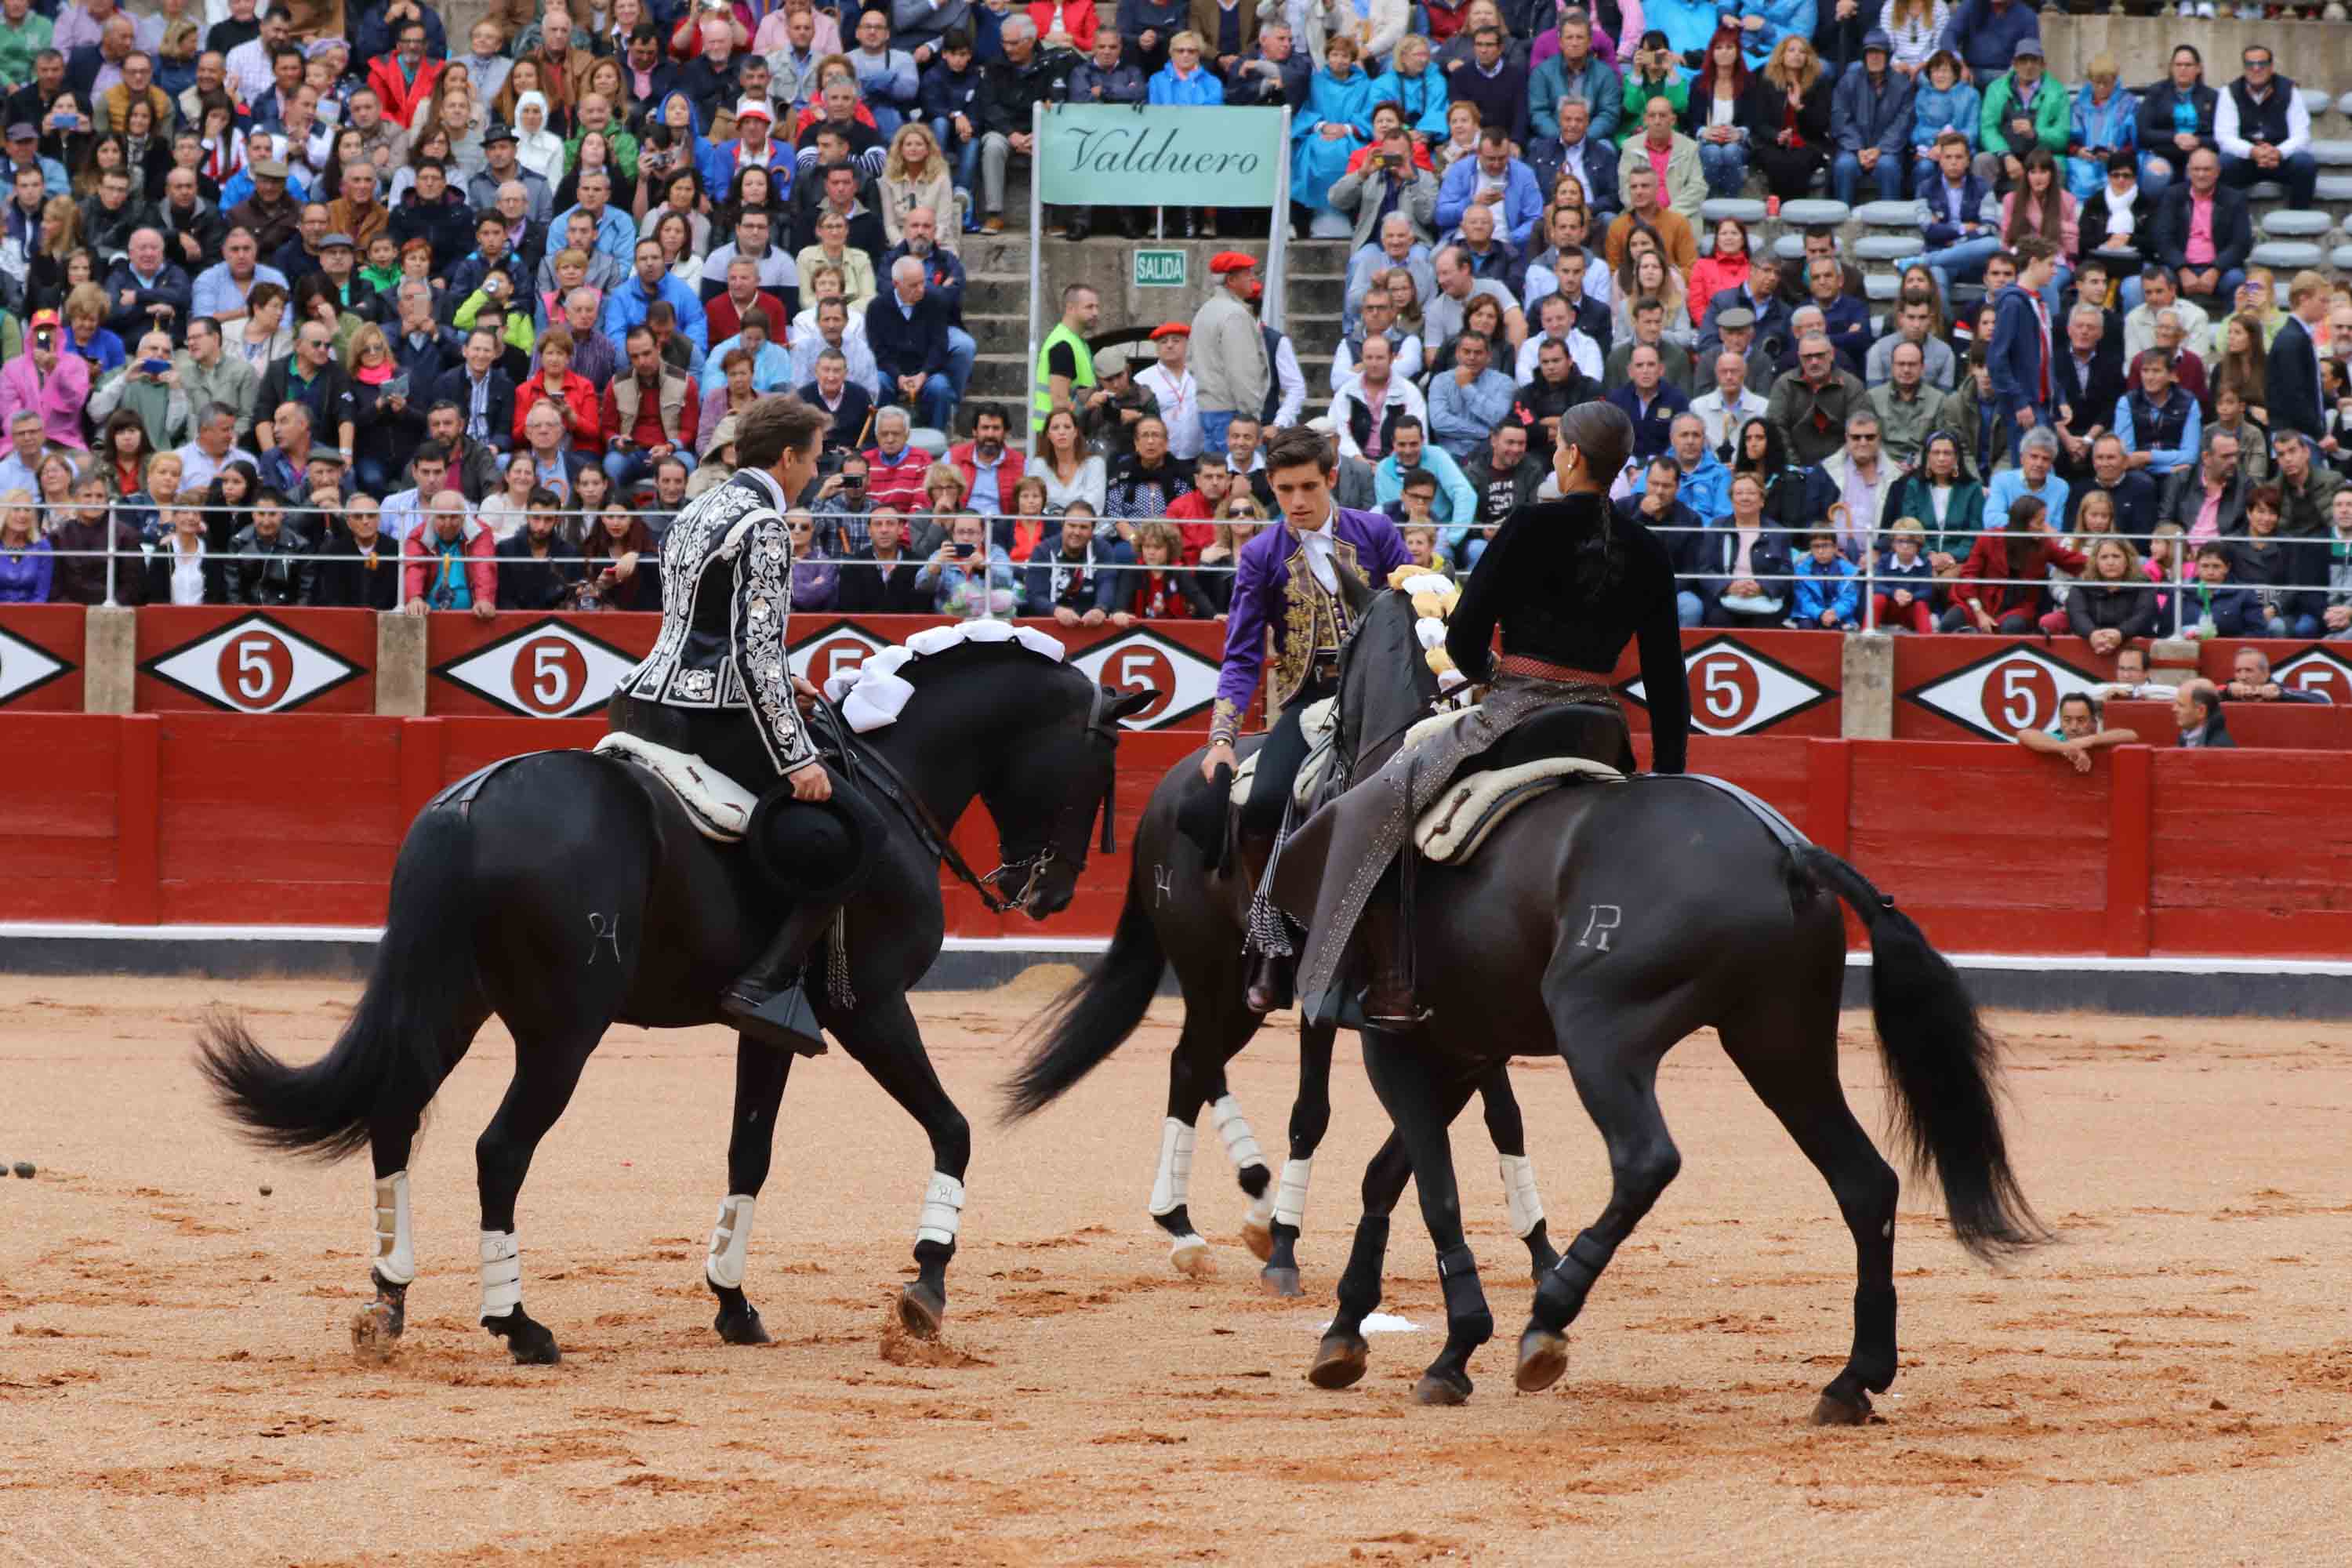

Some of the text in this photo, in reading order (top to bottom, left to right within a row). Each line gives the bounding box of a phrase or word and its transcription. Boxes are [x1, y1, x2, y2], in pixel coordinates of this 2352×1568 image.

[1065, 126, 1260, 175] Valduero
[1138, 256, 1183, 280] SALIDA
[238, 641, 274, 699] 5
[534, 646, 568, 705] 5
[1121, 655, 1156, 716] 5
[1704, 662, 1743, 717] 5
[2004, 668, 2038, 729] 5
